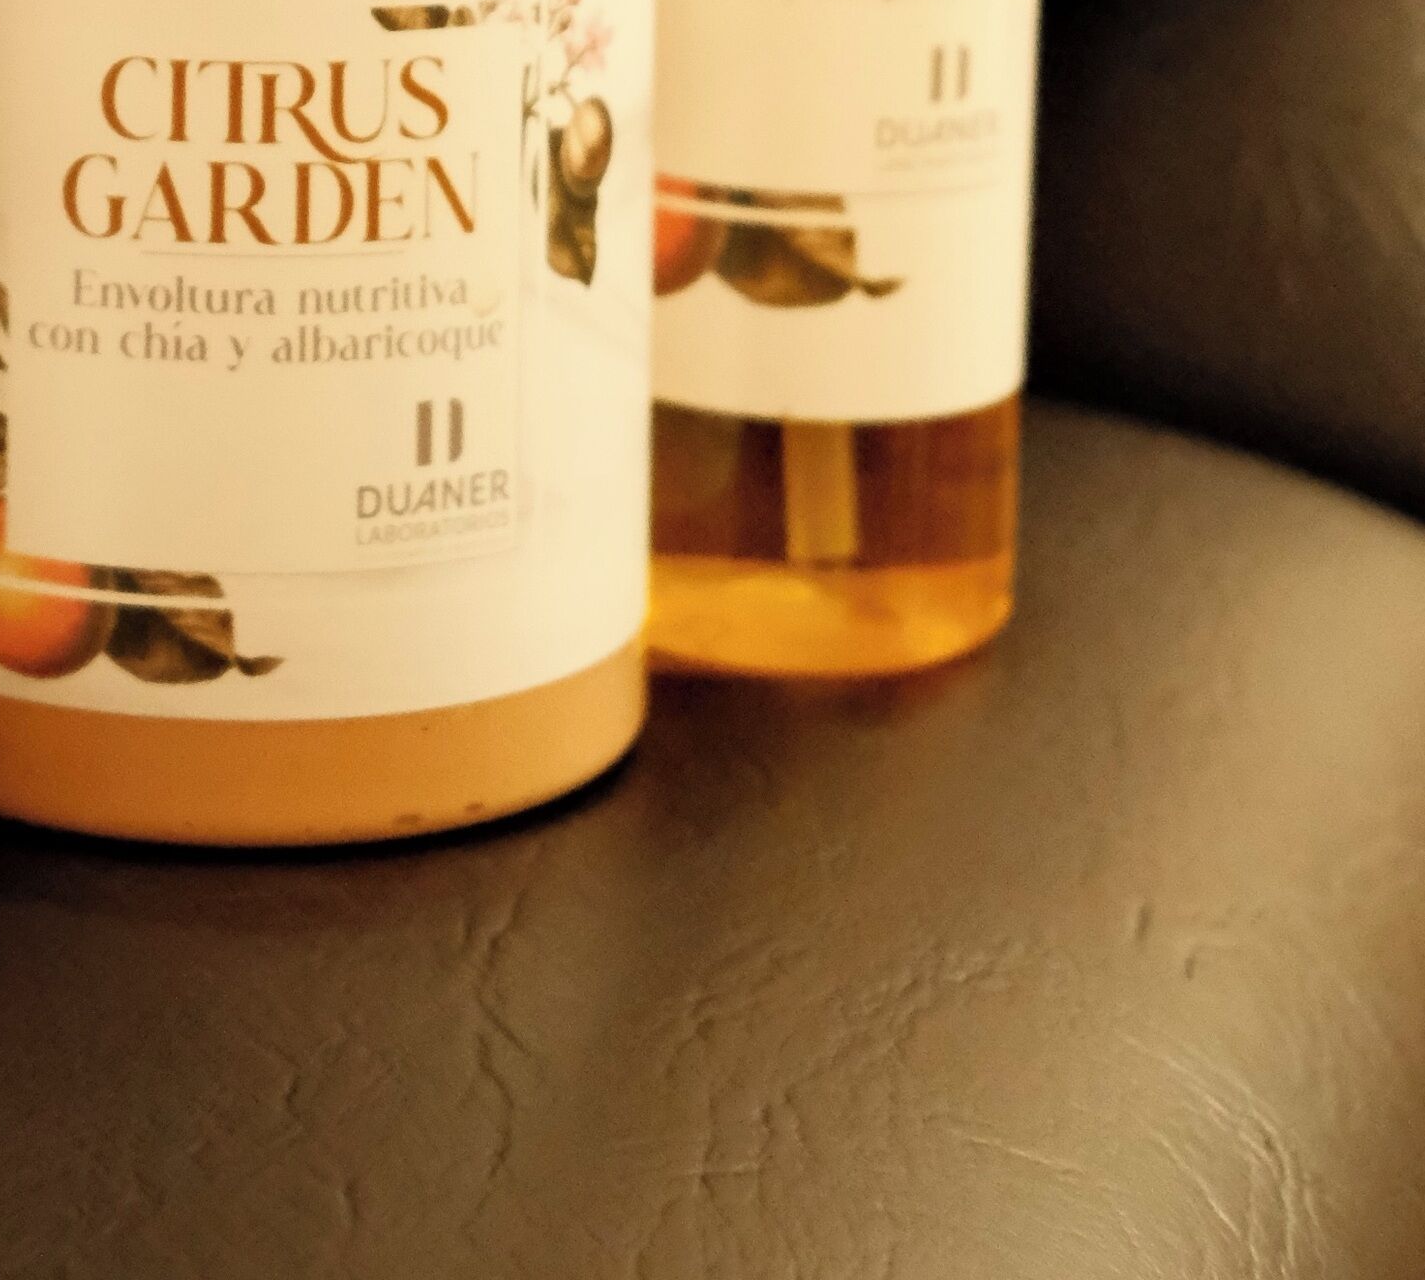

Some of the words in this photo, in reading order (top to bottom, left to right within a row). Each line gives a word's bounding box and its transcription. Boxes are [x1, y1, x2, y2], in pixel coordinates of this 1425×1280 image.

[101, 56, 449, 164] CITRUS
[62, 152, 479, 246] GARDEN
[73, 268, 276, 316] Envoltura
[298, 274, 468, 314] nutritiva
[29, 321, 100, 356] con
[121, 322, 208, 363] chía
[228, 342, 249, 371] y
[272, 317, 505, 364] albaricoque
[357, 469, 511, 519] DUANER
